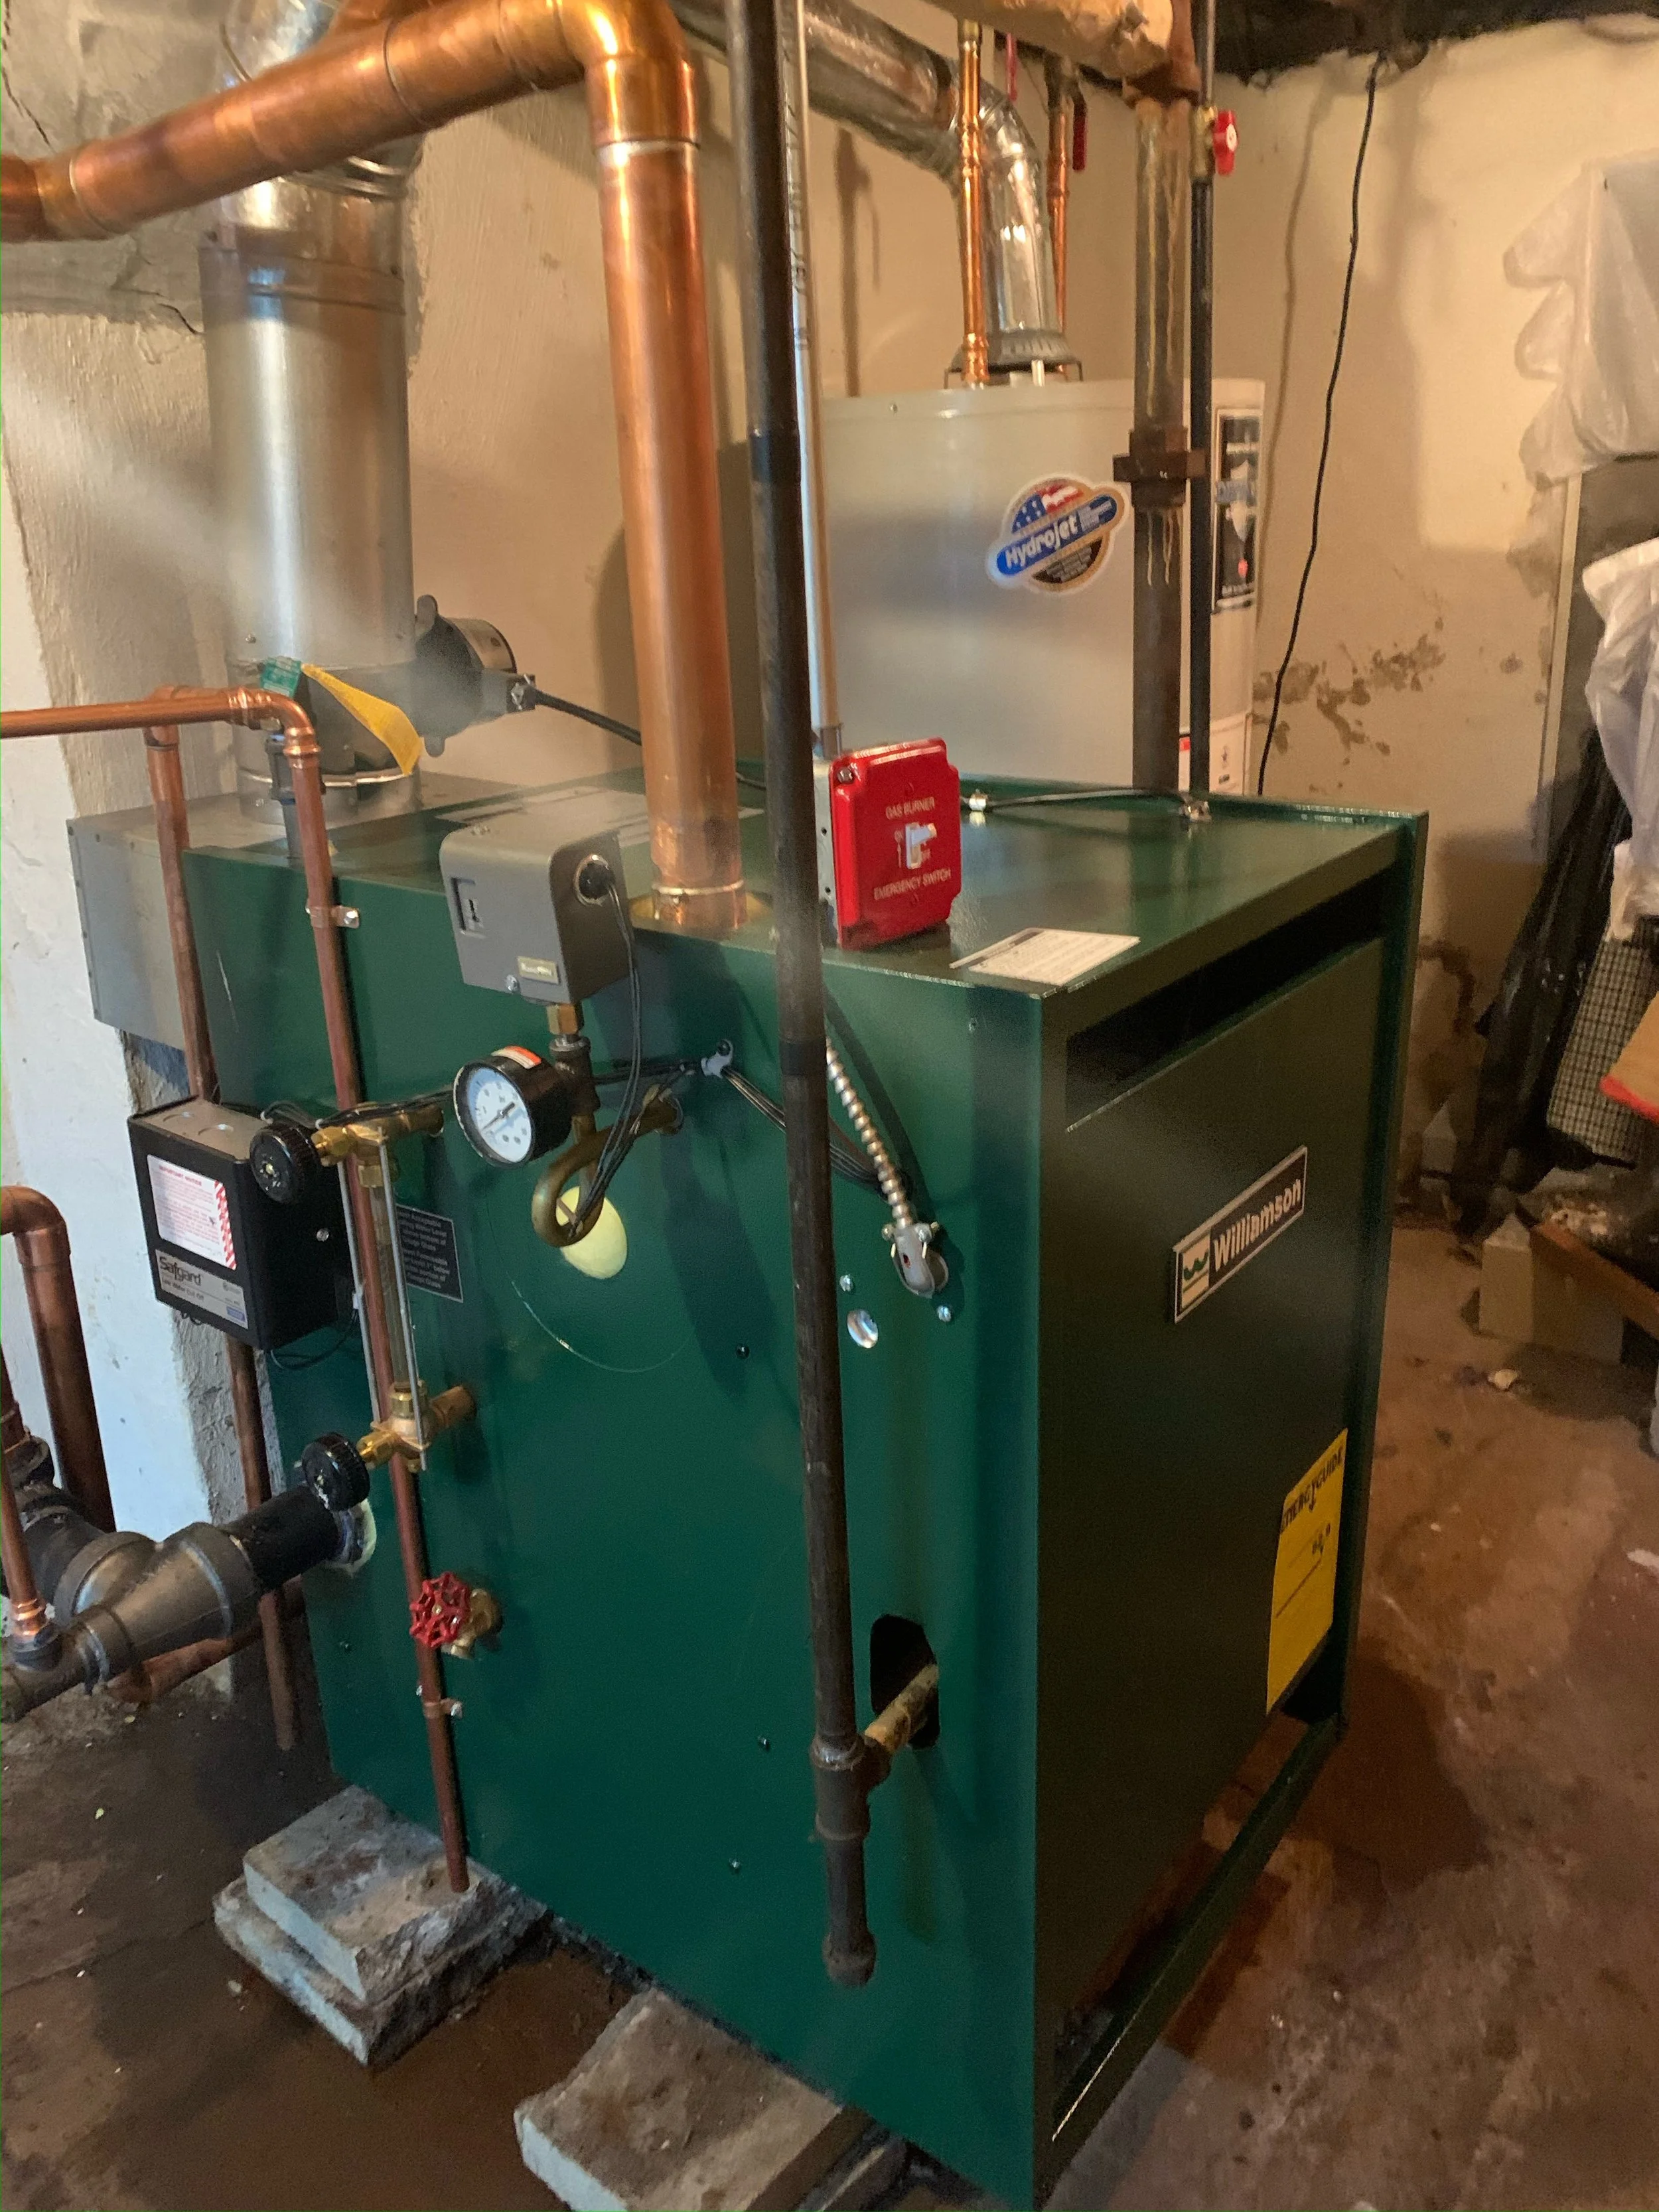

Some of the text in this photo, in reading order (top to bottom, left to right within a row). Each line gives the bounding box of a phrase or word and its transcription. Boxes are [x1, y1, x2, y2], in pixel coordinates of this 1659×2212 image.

[885, 796, 936, 820] GAS BURNER
[873, 867, 952, 901] EMERGENCY SWITCH
[1212, 1179, 1301, 1272] Williamson
[159, 1256, 201, 1286] Safgard
